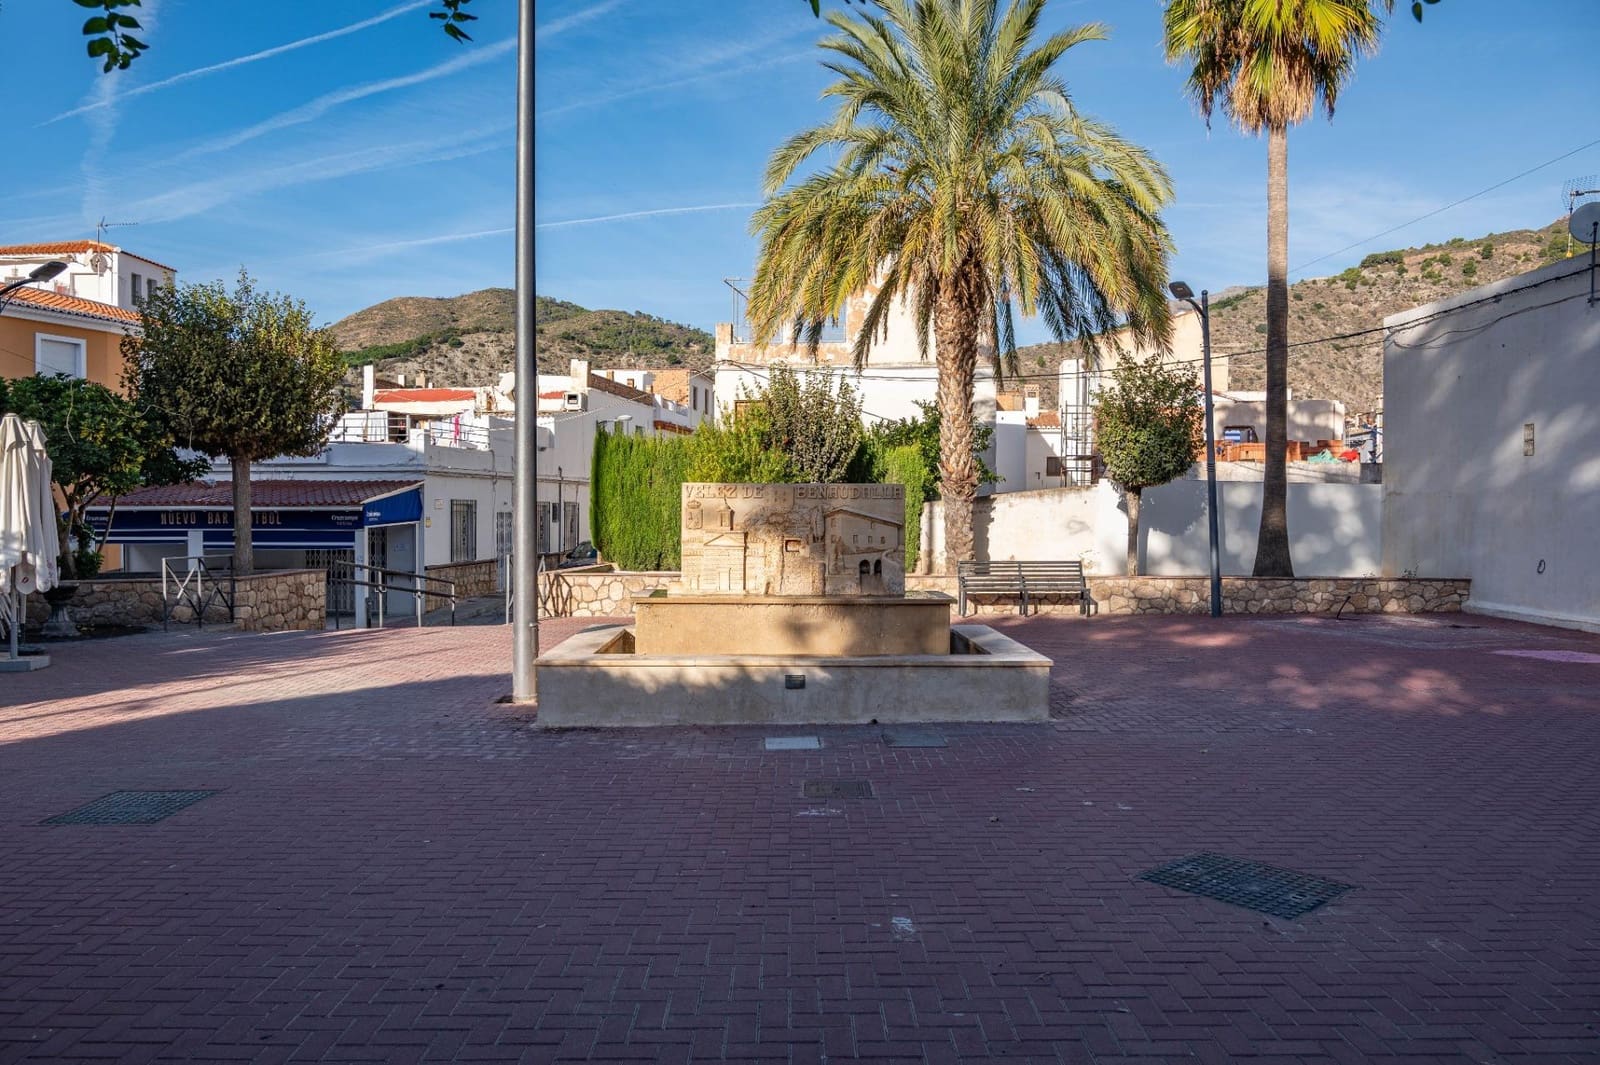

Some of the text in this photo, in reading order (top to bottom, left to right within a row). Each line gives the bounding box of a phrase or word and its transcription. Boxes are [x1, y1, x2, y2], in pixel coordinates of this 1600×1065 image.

[743, 485, 764, 499] DE
[160, 511, 282, 525] NUEVO BAR TBOL
